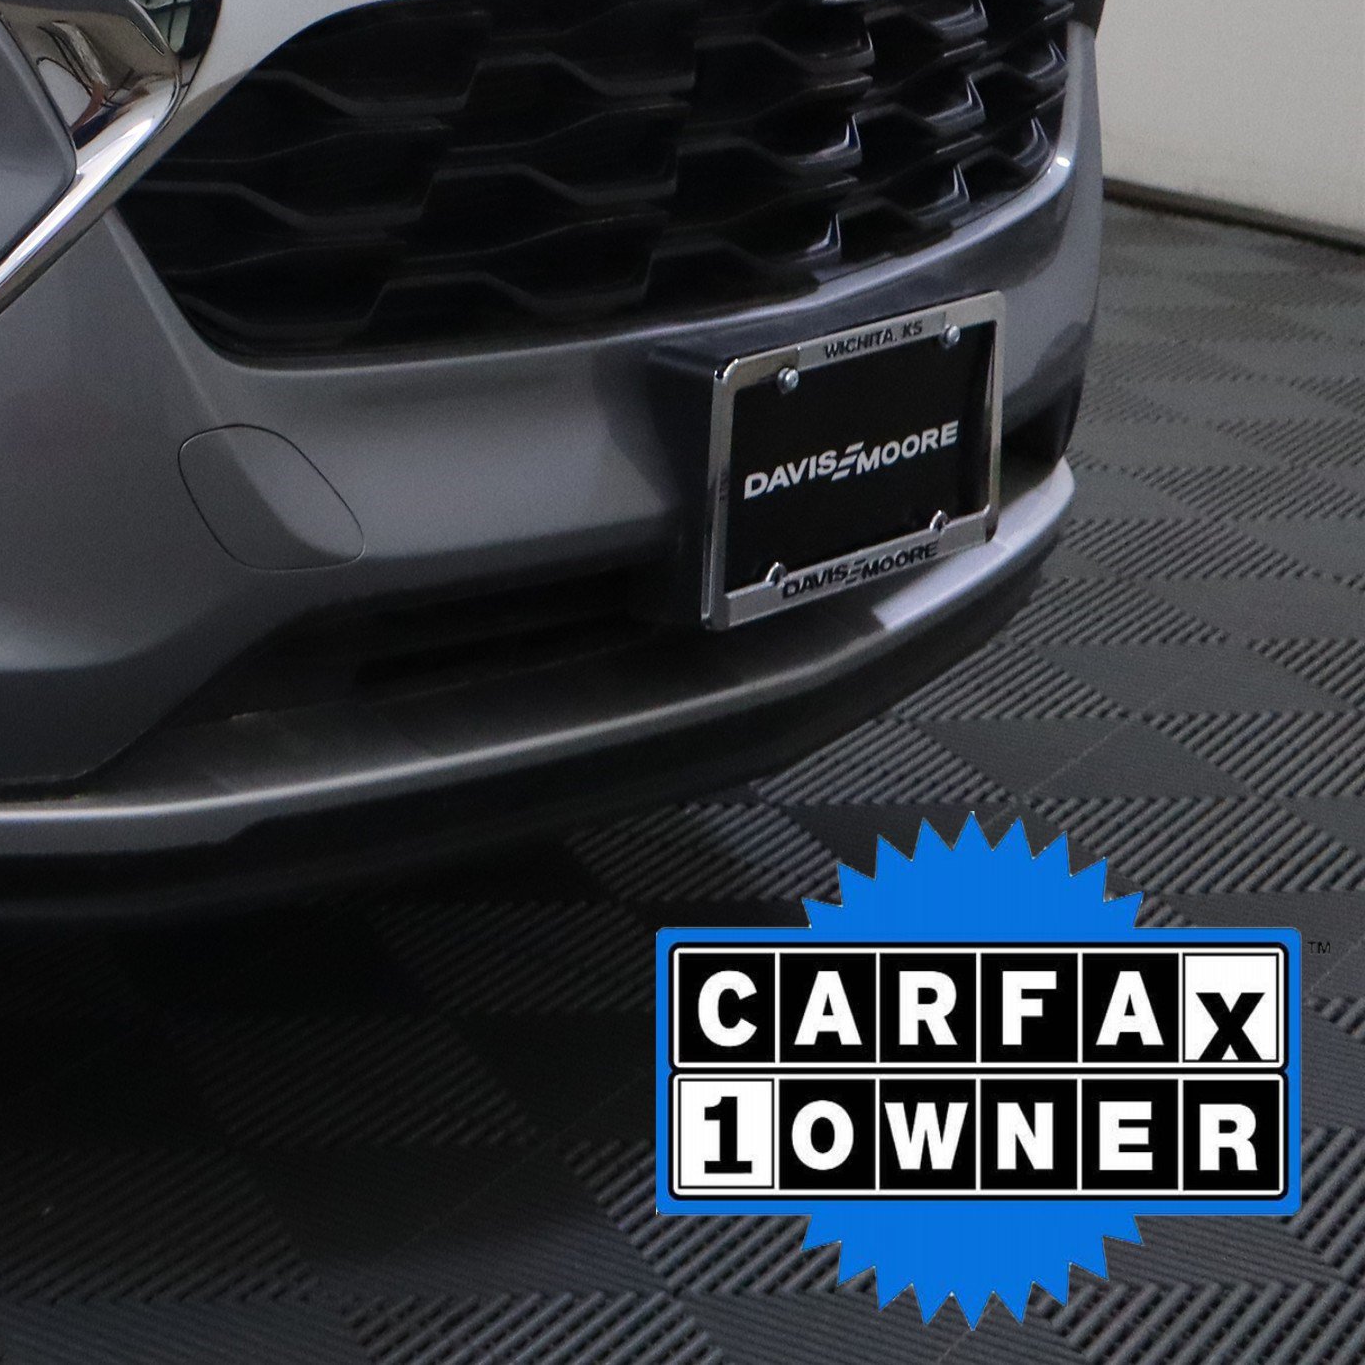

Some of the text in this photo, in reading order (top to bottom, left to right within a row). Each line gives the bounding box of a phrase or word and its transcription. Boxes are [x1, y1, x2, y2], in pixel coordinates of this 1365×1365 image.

[902, 320, 923, 338] KS
[744, 420, 959, 500] DAVIS MOORE
[782, 540, 941, 600] DAVIS MOORE
